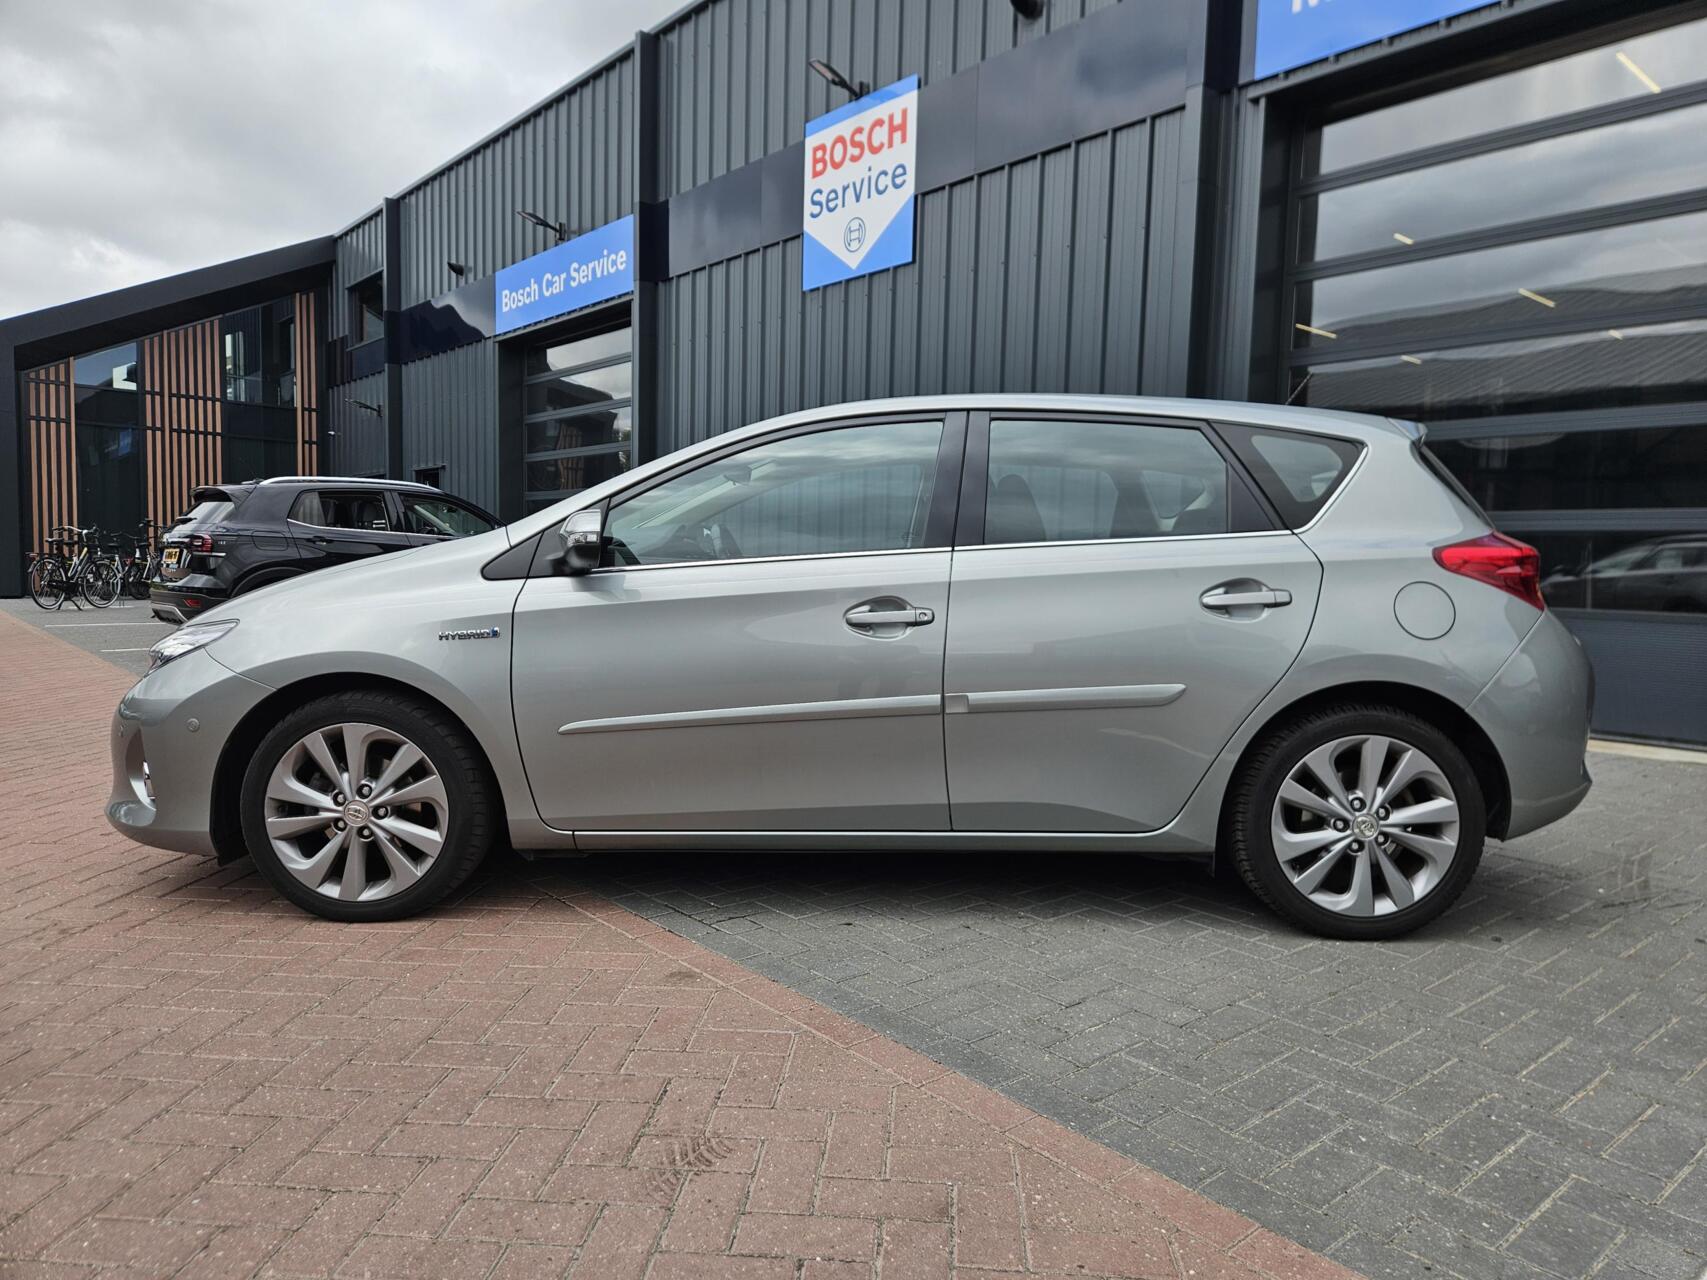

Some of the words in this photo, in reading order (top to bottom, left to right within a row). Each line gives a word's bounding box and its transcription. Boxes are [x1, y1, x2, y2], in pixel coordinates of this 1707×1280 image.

[811, 107, 908, 179] BOSCH
[809, 163, 907, 219] Service
[502, 278, 539, 313] Bosch
[542, 272, 566, 297] Car
[570, 249, 627, 288] Service
[438, 629, 491, 641] HYBRID
